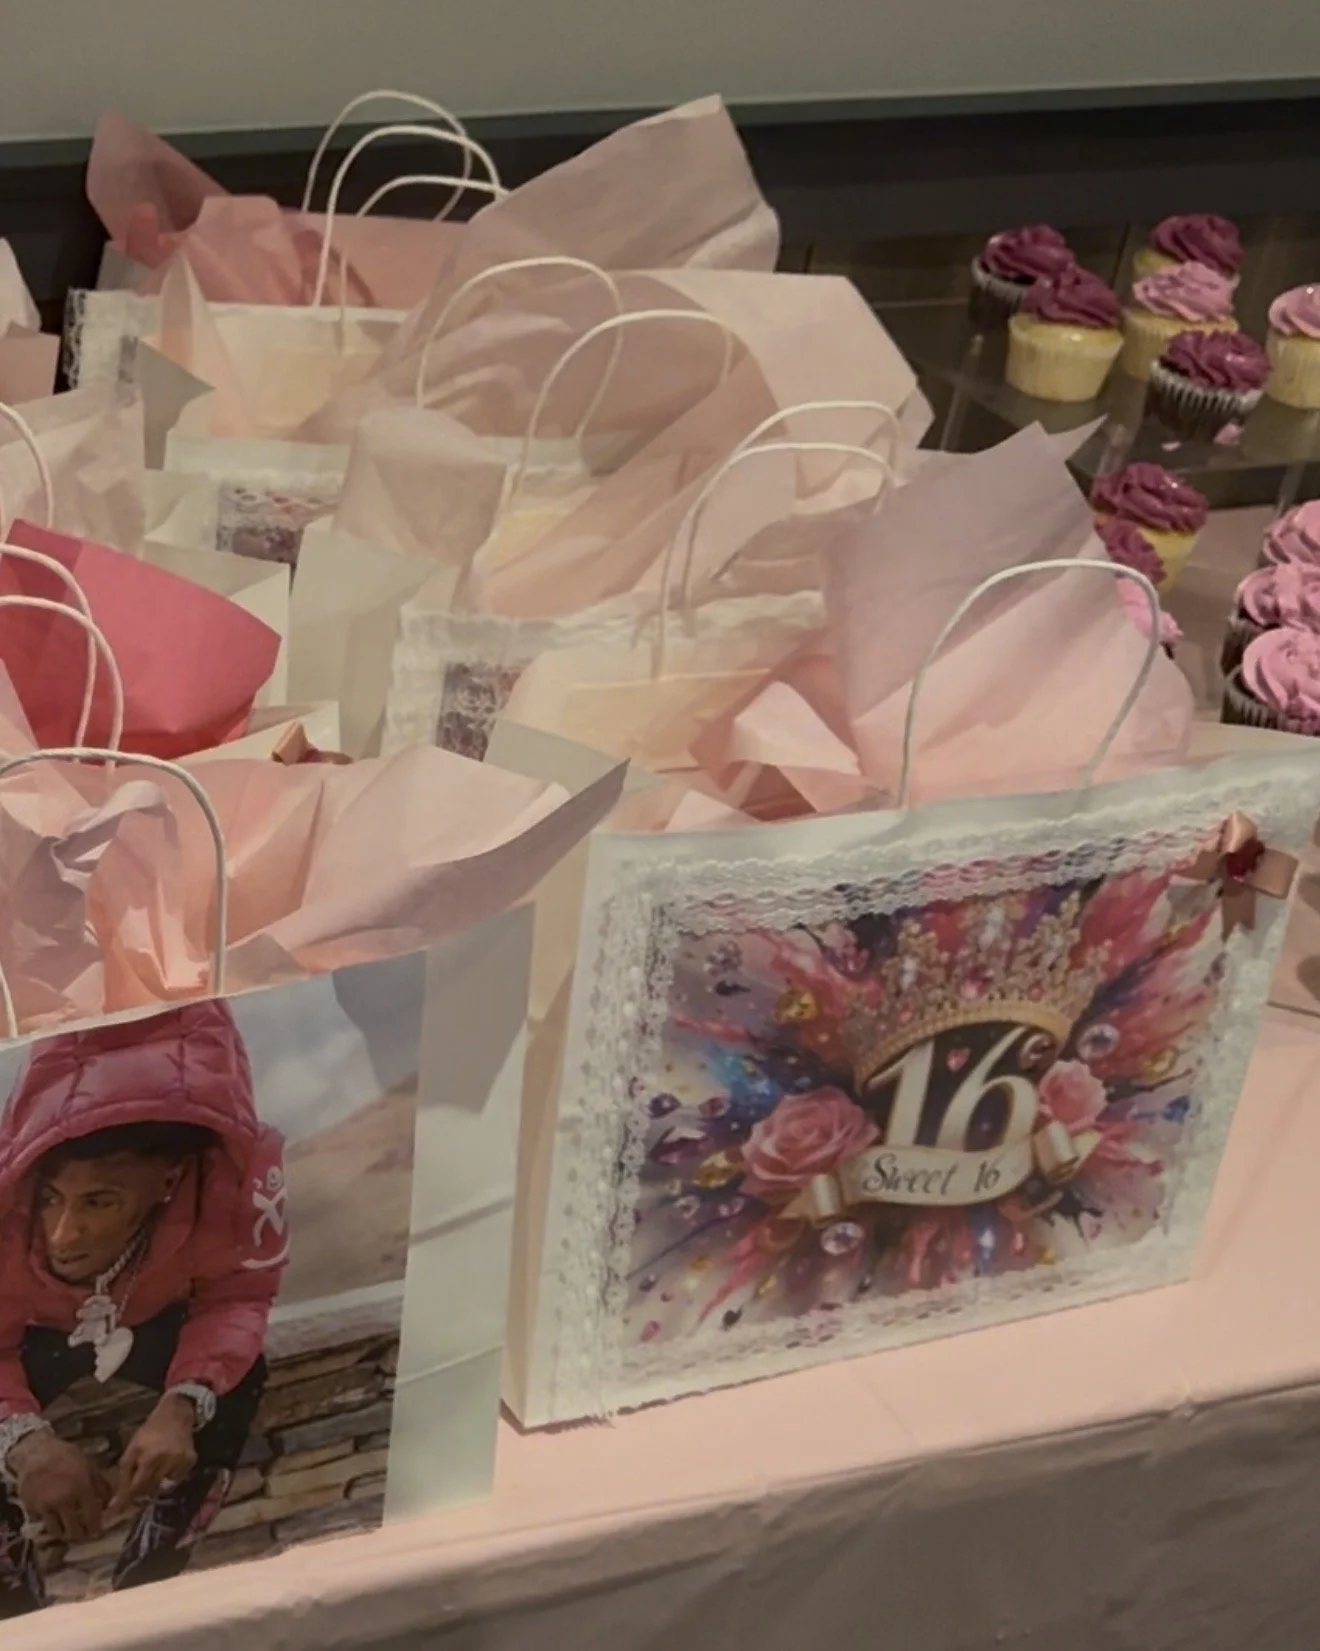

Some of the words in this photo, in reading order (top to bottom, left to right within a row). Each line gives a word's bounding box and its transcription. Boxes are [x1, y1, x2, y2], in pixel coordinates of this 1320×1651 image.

[867, 1026, 1038, 1151] 16
[862, 1153, 956, 1195] Sweet
[973, 1159, 1001, 1193] 16
